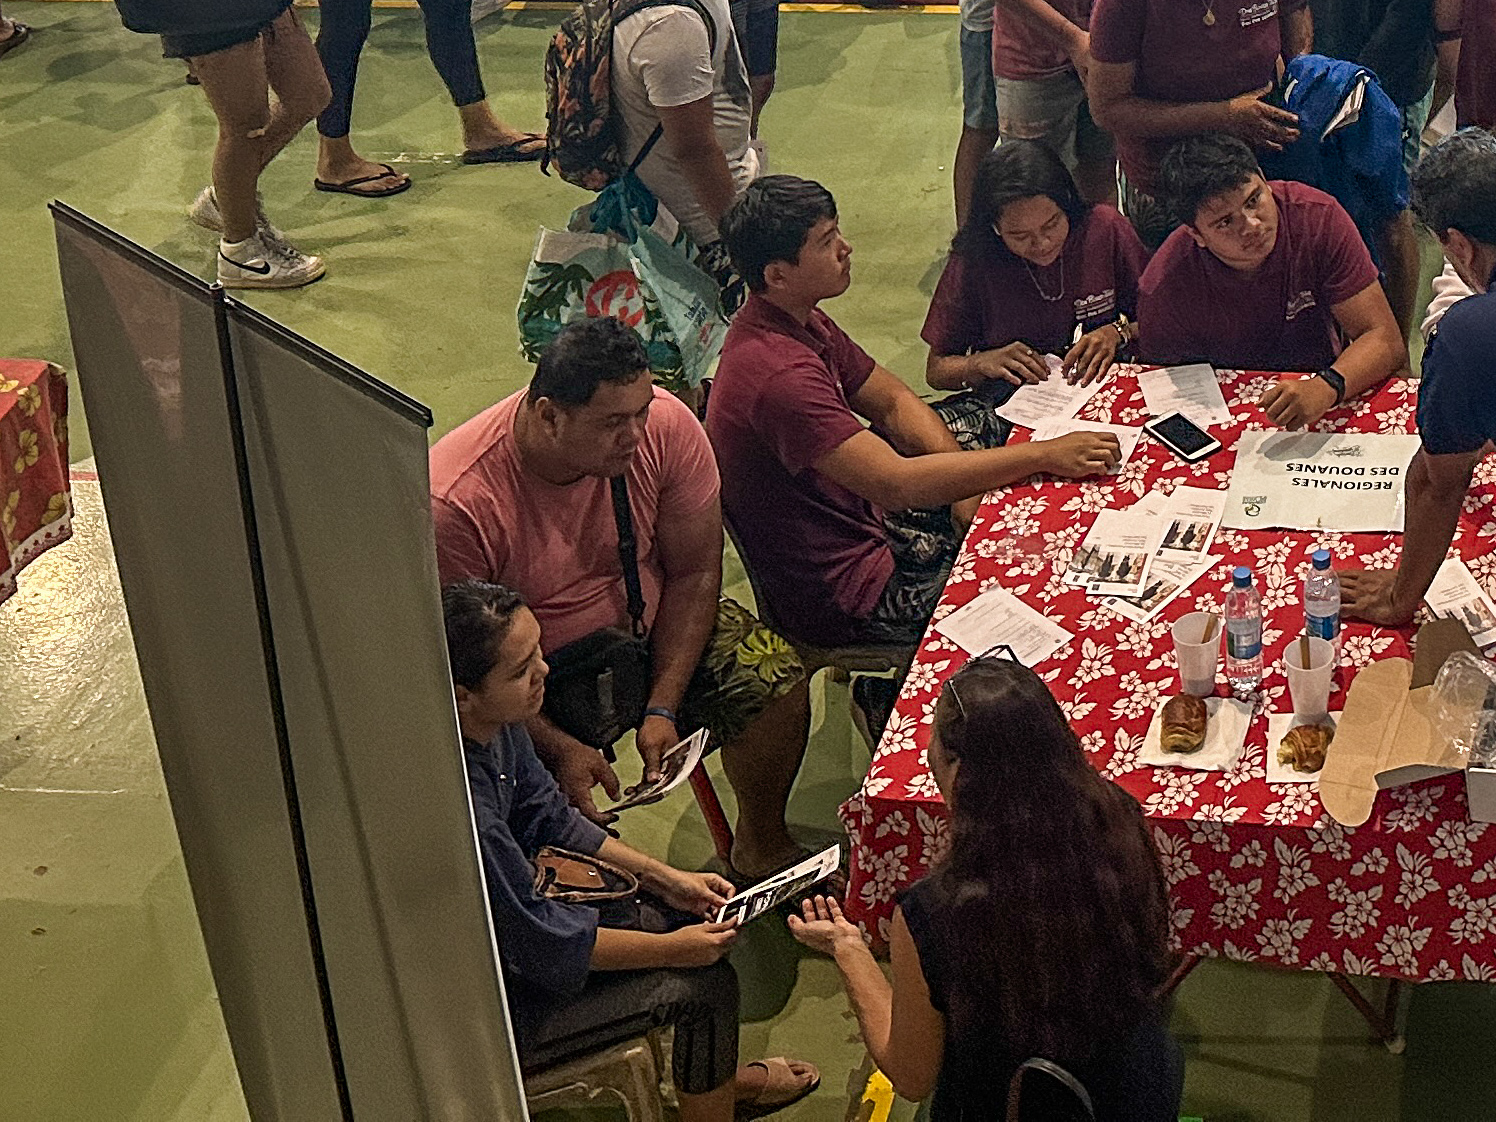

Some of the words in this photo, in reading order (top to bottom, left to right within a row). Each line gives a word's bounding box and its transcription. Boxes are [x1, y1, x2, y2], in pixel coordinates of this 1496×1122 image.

[1285, 463, 1365, 476] DOUANES
[1369, 466, 1400, 476] DES
[1291, 477, 1393, 490] REGIONALES
